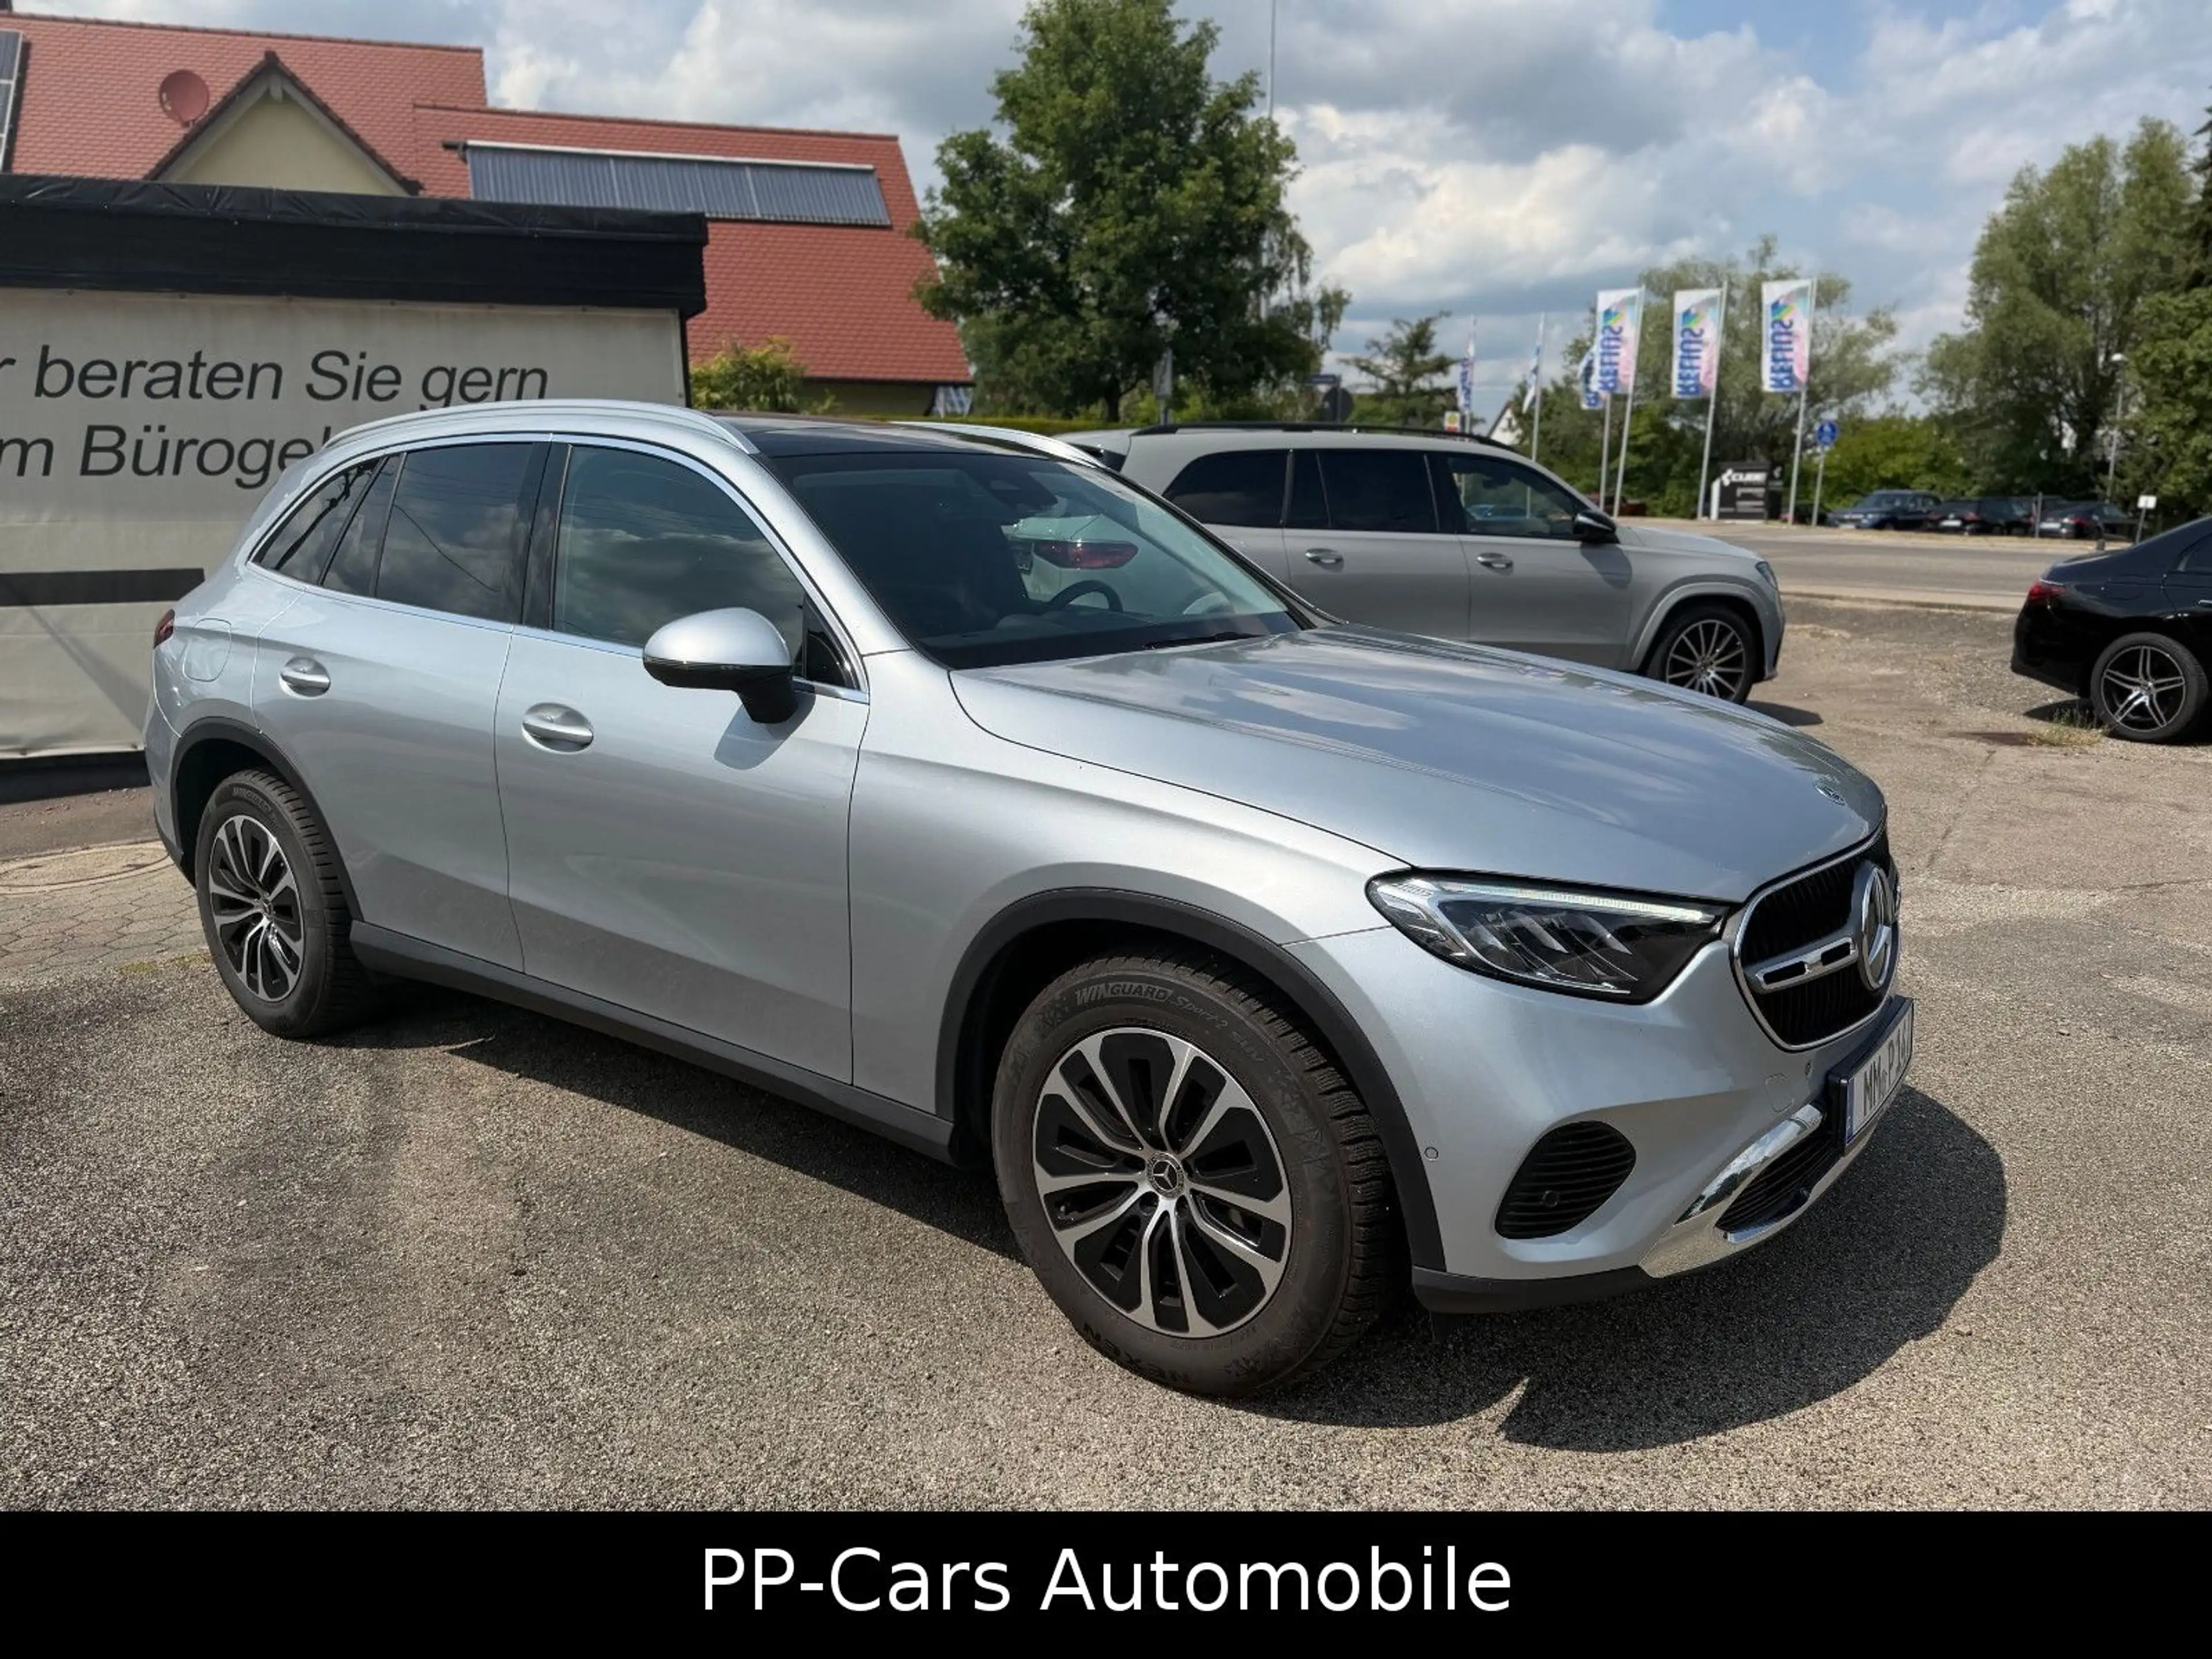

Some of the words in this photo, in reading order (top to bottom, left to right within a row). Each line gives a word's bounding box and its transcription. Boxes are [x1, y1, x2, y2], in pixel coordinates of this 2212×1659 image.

[35, 344, 283, 399] beraten
[305, 350, 402, 402] Sie
[420, 366, 547, 410] gern
[79, 424, 331, 489] Büroge
[1075, 982, 1172, 1006] WINGUARD
